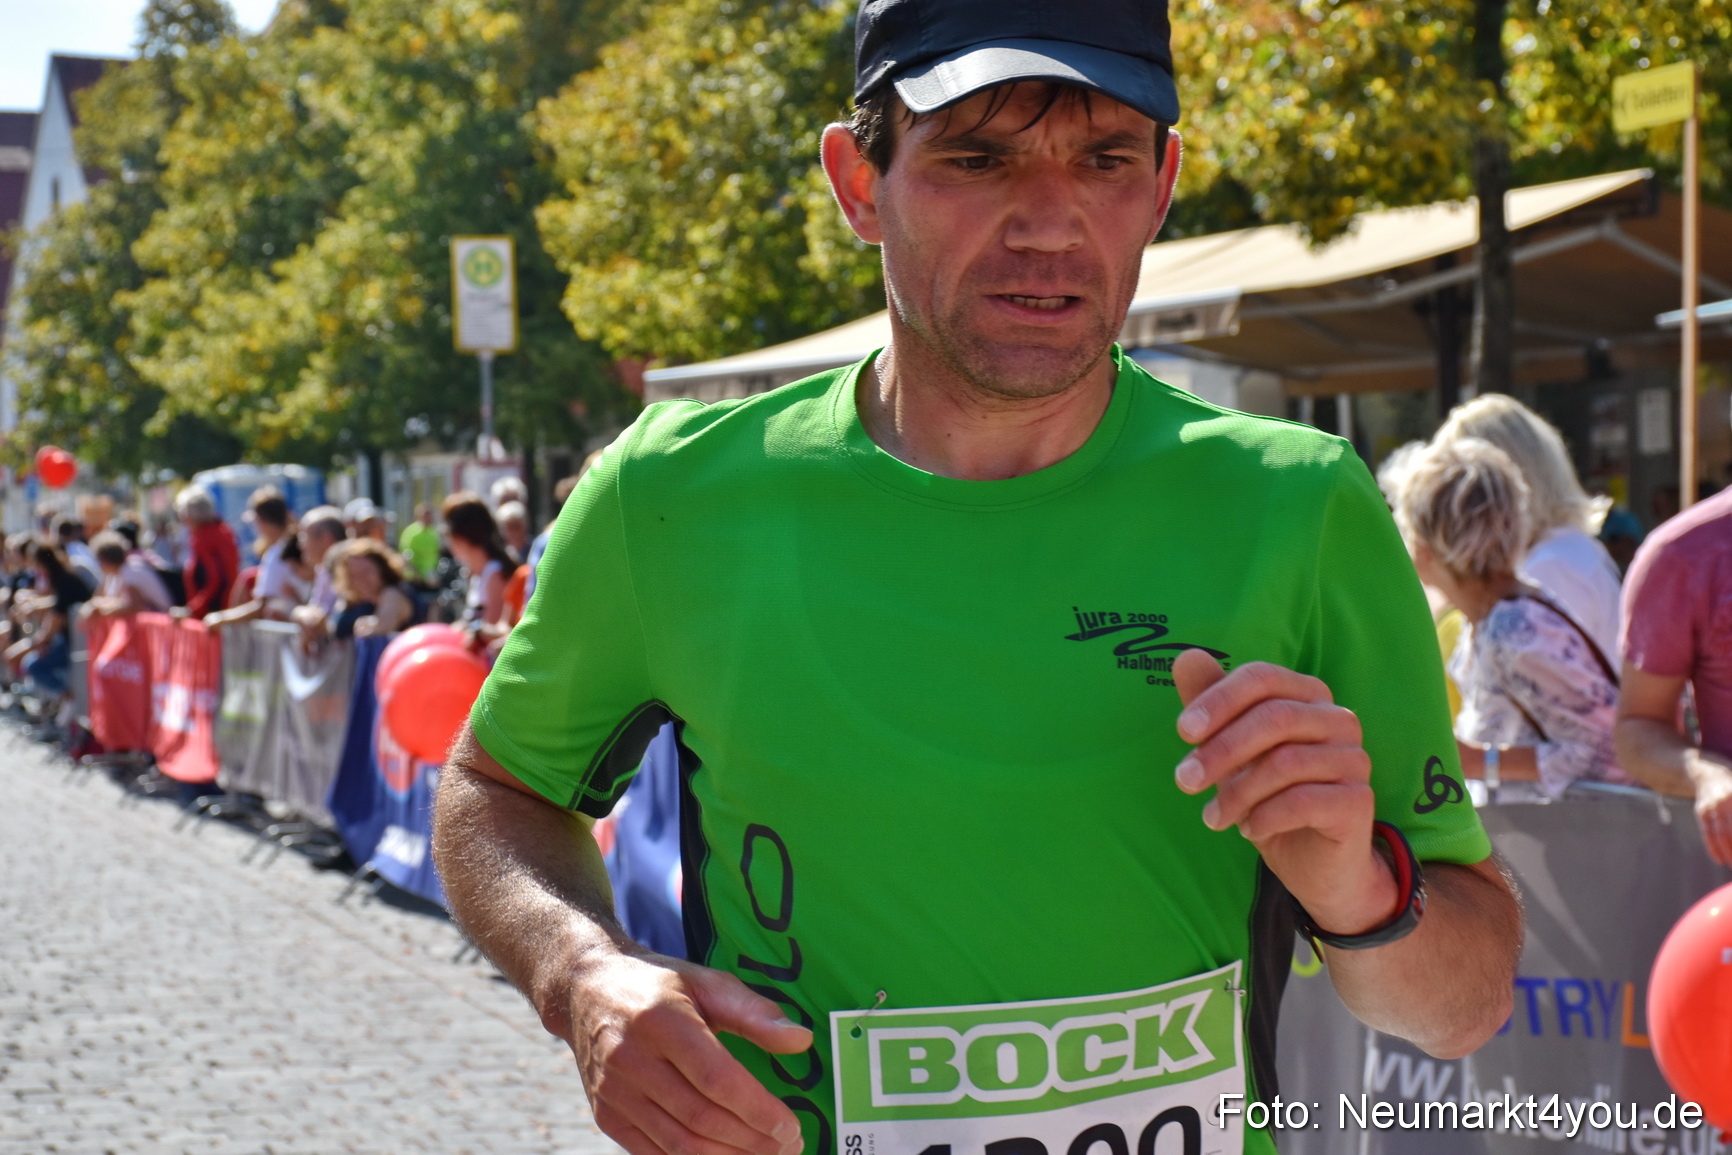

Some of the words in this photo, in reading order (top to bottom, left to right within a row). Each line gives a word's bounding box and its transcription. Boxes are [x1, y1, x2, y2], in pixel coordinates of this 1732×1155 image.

[1072, 606, 1122, 641] jura
[1127, 613, 1168, 624] 2000
[876, 998, 1202, 1097] BOCK
